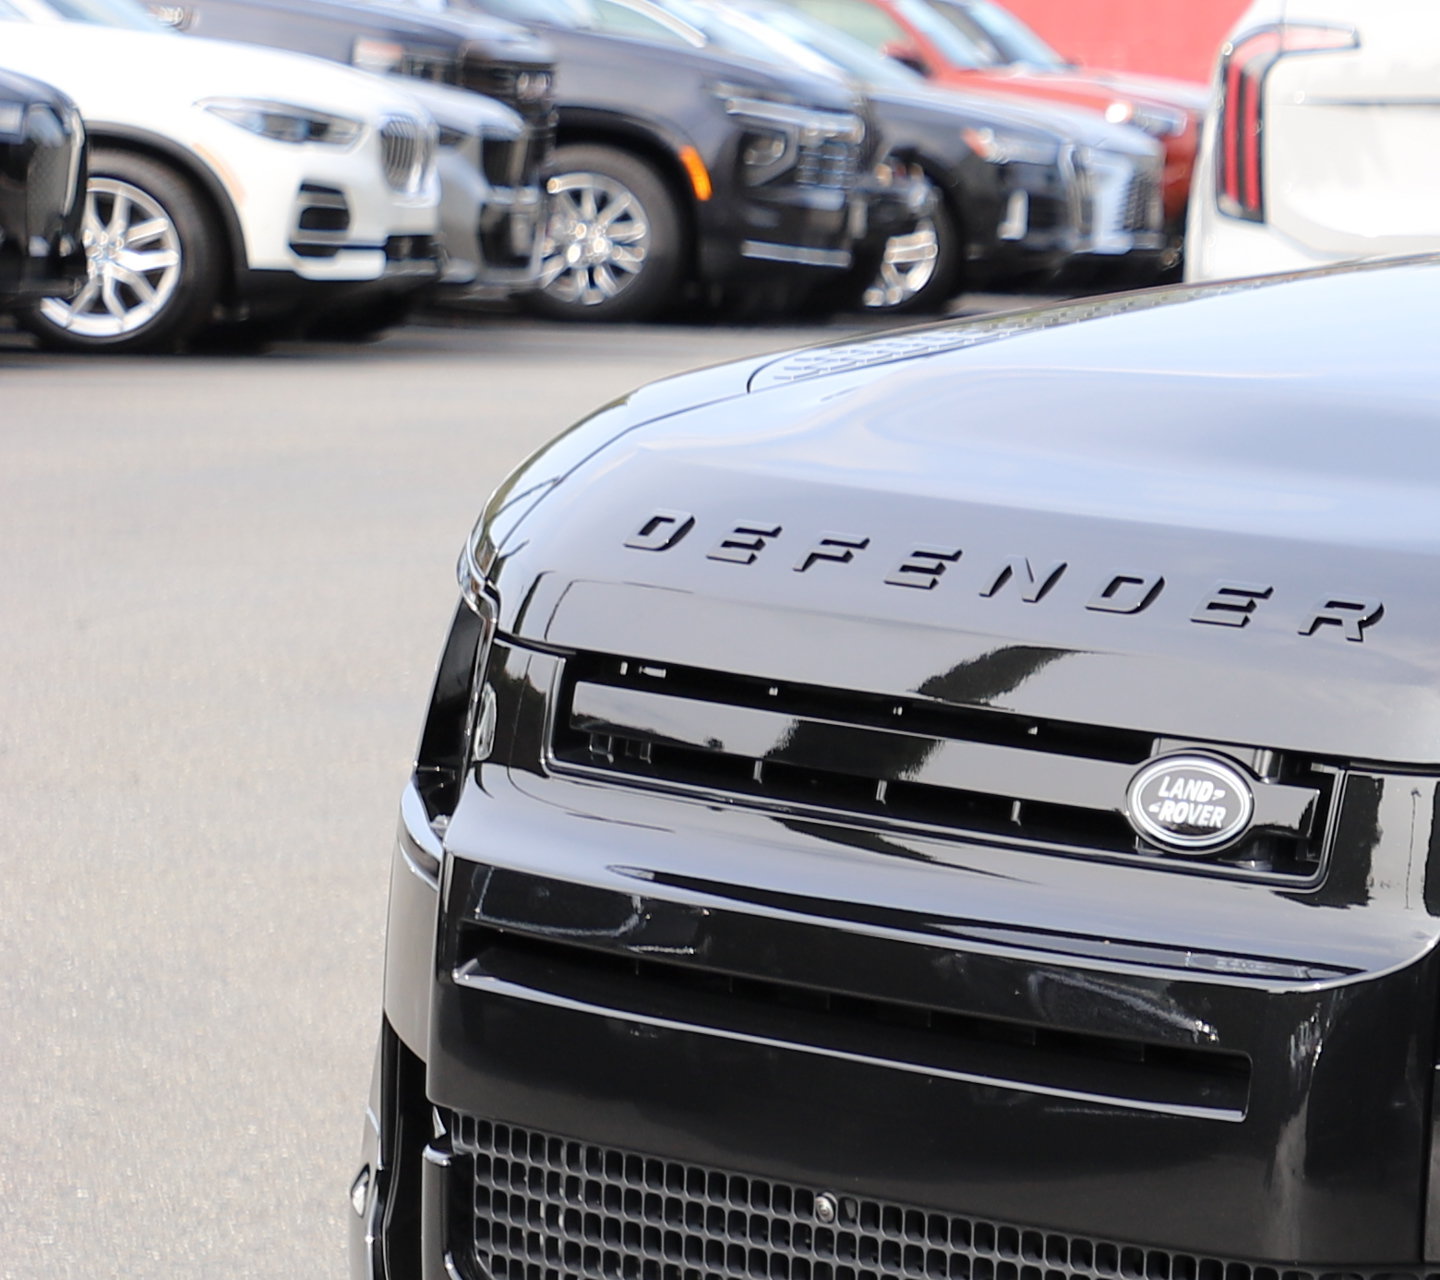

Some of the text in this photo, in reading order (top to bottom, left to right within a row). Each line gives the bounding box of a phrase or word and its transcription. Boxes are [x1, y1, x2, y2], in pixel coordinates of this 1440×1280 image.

[622, 510, 1385, 642] DEFENDER
[1157, 775, 1216, 803] LAND
[1157, 800, 1228, 829] ROVER
